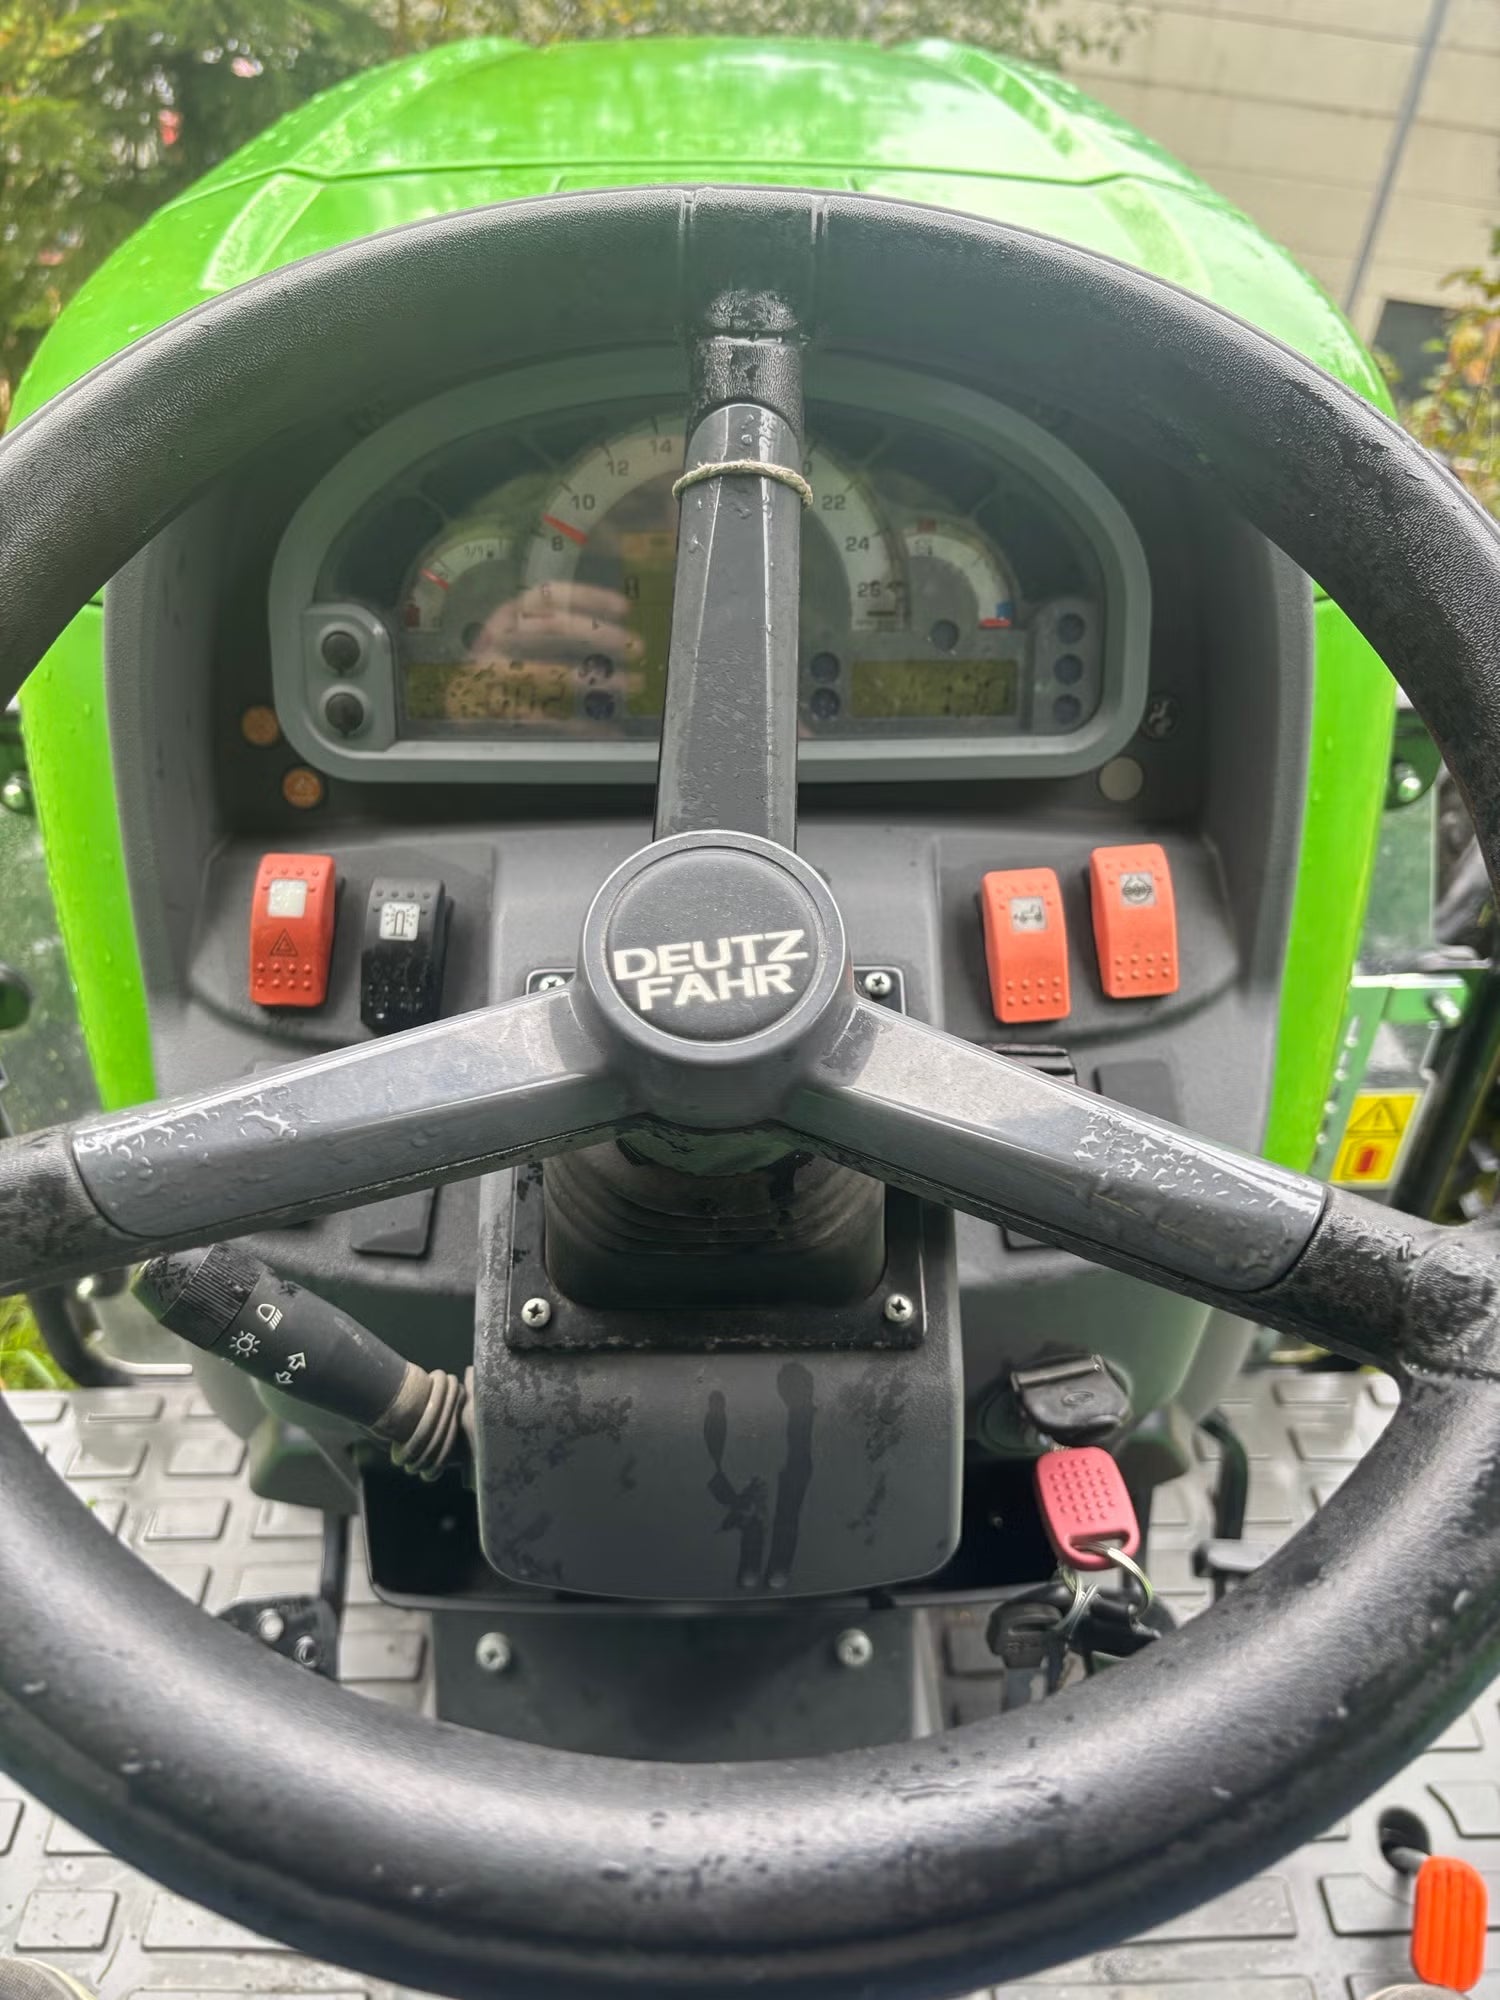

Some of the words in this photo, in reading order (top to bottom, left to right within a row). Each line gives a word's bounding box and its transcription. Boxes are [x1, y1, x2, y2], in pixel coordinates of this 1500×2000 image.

[648, 438, 673, 454] 14
[607, 460, 630, 476] 12
[571, 493, 596, 511] 10
[821, 495, 846, 511] 22
[551, 535, 564, 551] 8
[845, 536, 870, 552] 24
[857, 580, 881, 598] 26
[612, 928, 810, 981] DEUTZ
[637, 962, 796, 1011] FAHR
